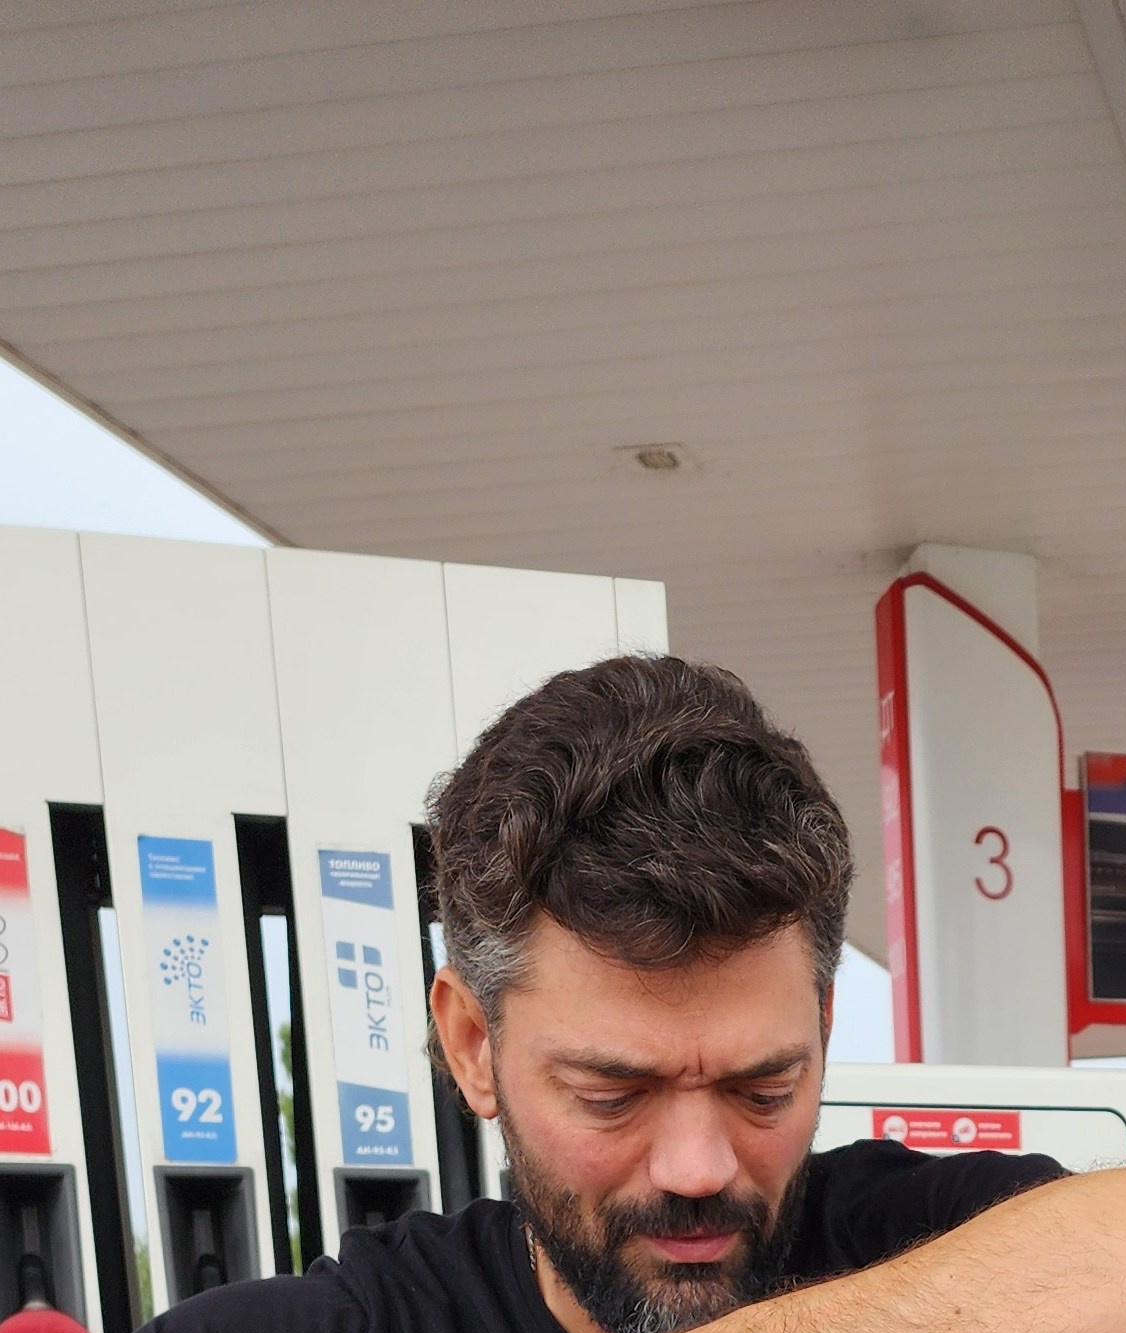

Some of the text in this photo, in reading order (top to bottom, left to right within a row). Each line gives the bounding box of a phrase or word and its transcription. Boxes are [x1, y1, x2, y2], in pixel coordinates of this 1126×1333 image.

[328, 858, 380, 871] ТОПЛИВО
[974, 826, 1013, 900] 3
[186, 961, 206, 1025] ЭКТО
[365, 972, 389, 1051] ЭКТО
[0, 1080, 41, 1114] 00
[171, 1087, 223, 1123] 92
[355, 1105, 395, 1133] 95
